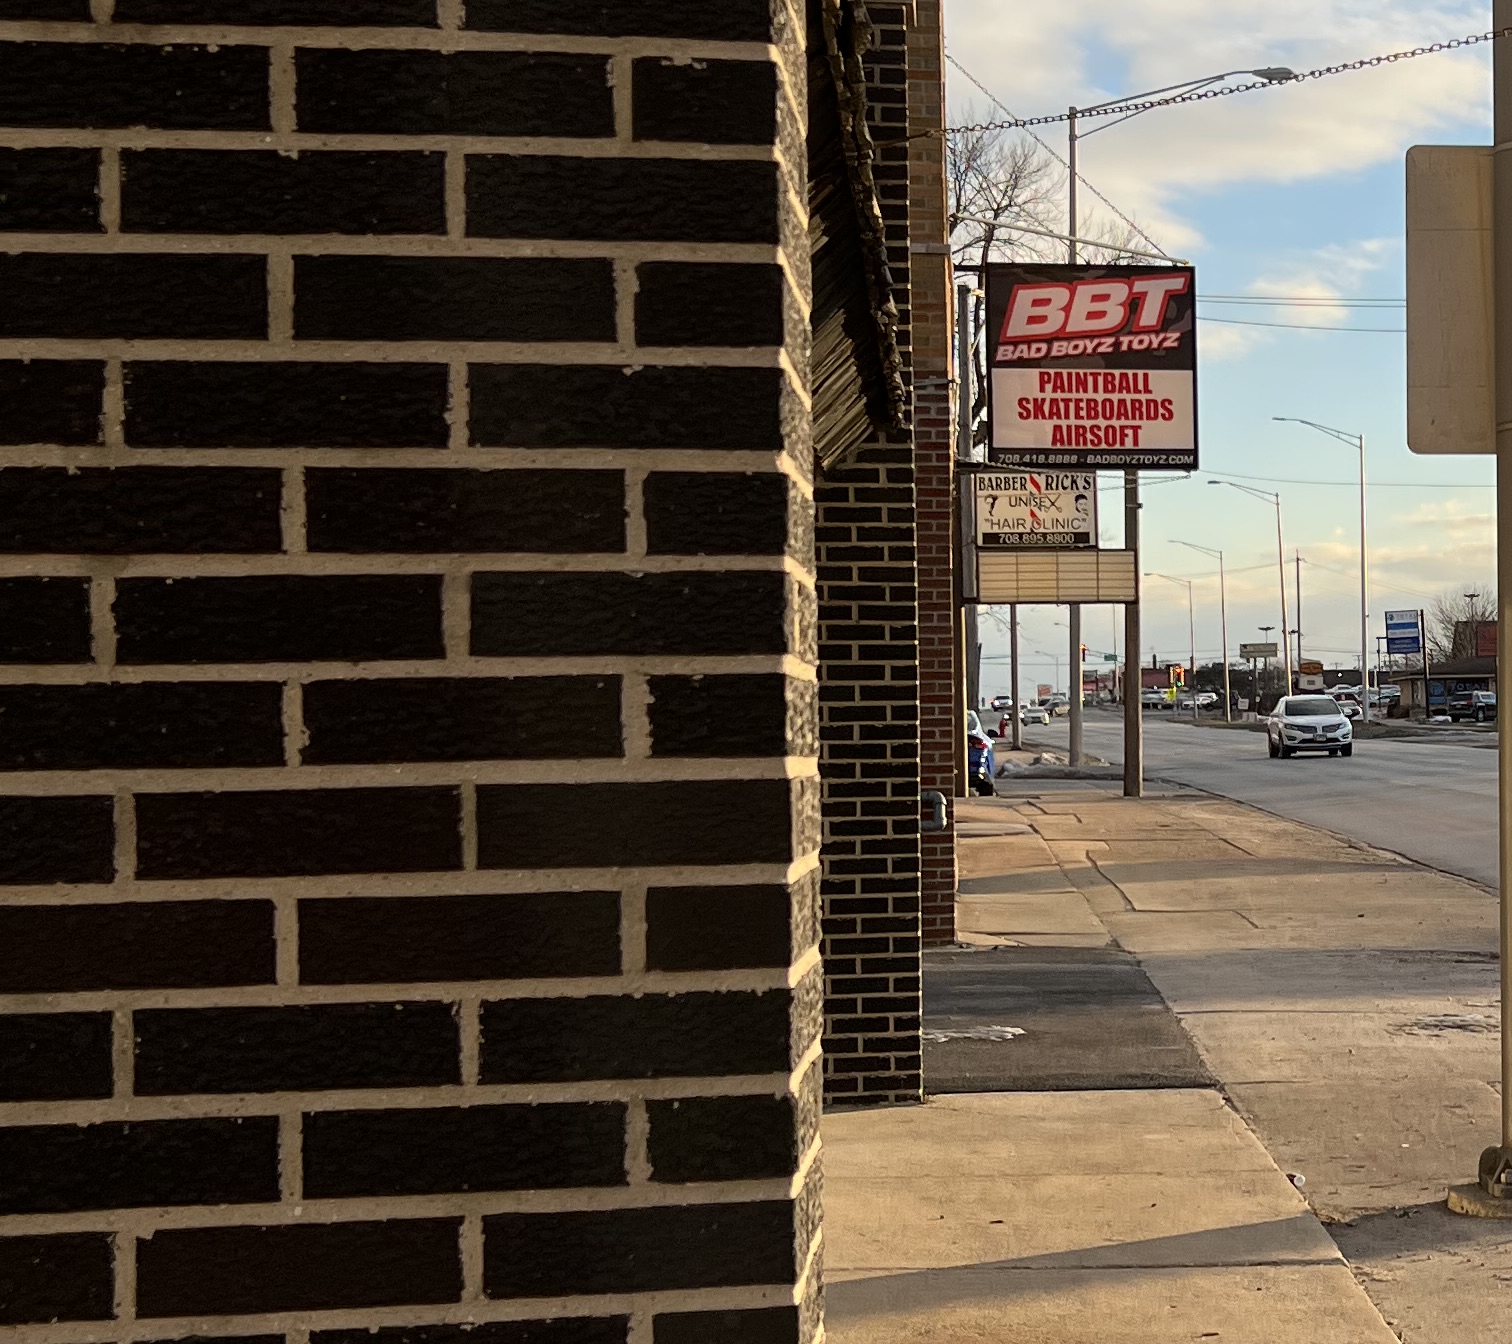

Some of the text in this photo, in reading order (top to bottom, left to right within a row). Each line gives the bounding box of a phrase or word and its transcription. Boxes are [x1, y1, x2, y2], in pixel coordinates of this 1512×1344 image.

[1003, 274, 1188, 339] BBT
[996, 332, 1181, 361] BAD BOYZ TOYZ
[1038, 371, 1153, 394] PAINTBALL
[1017, 397, 1174, 421] SKATEBOARDS
[1051, 424, 1142, 447] AIRSOFT
[1087, 454, 1194, 465] BADBOYZTOYZ.COM
[978, 474, 1091, 491] BARBER RICK'S
